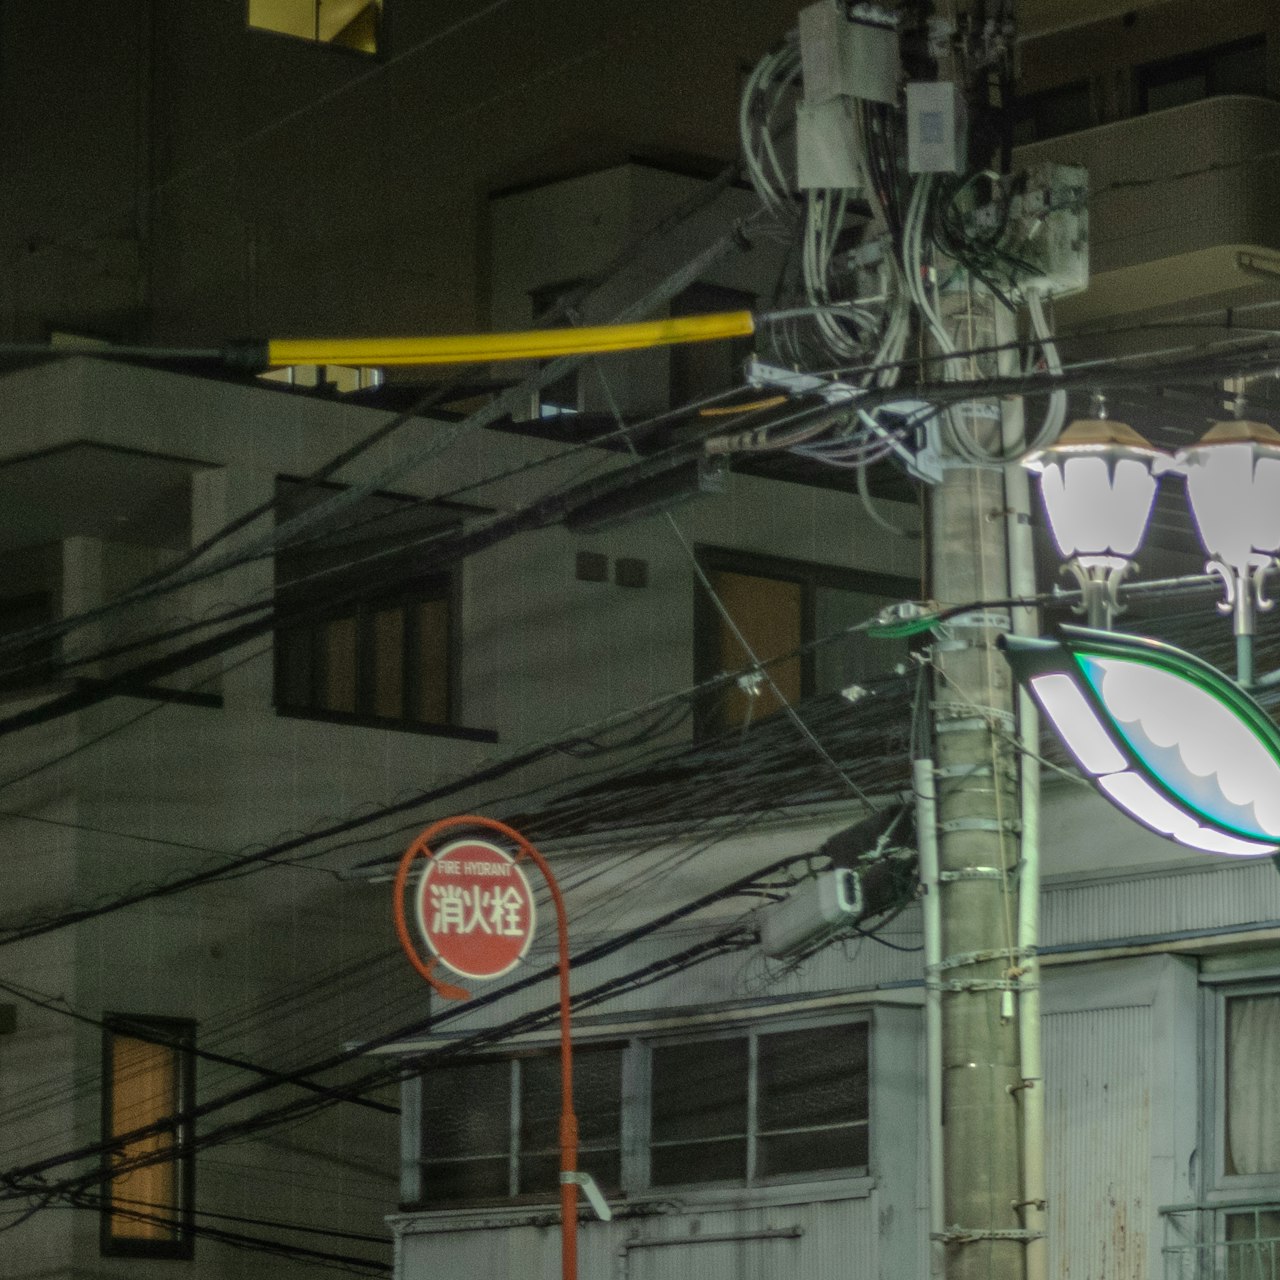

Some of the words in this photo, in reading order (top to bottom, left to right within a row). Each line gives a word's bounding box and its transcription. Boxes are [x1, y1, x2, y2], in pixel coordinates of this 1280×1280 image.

[437, 860, 461, 875] FIRE
[463, 861, 512, 877] HYDRANT
[430, 884, 524, 935] 消火栓
